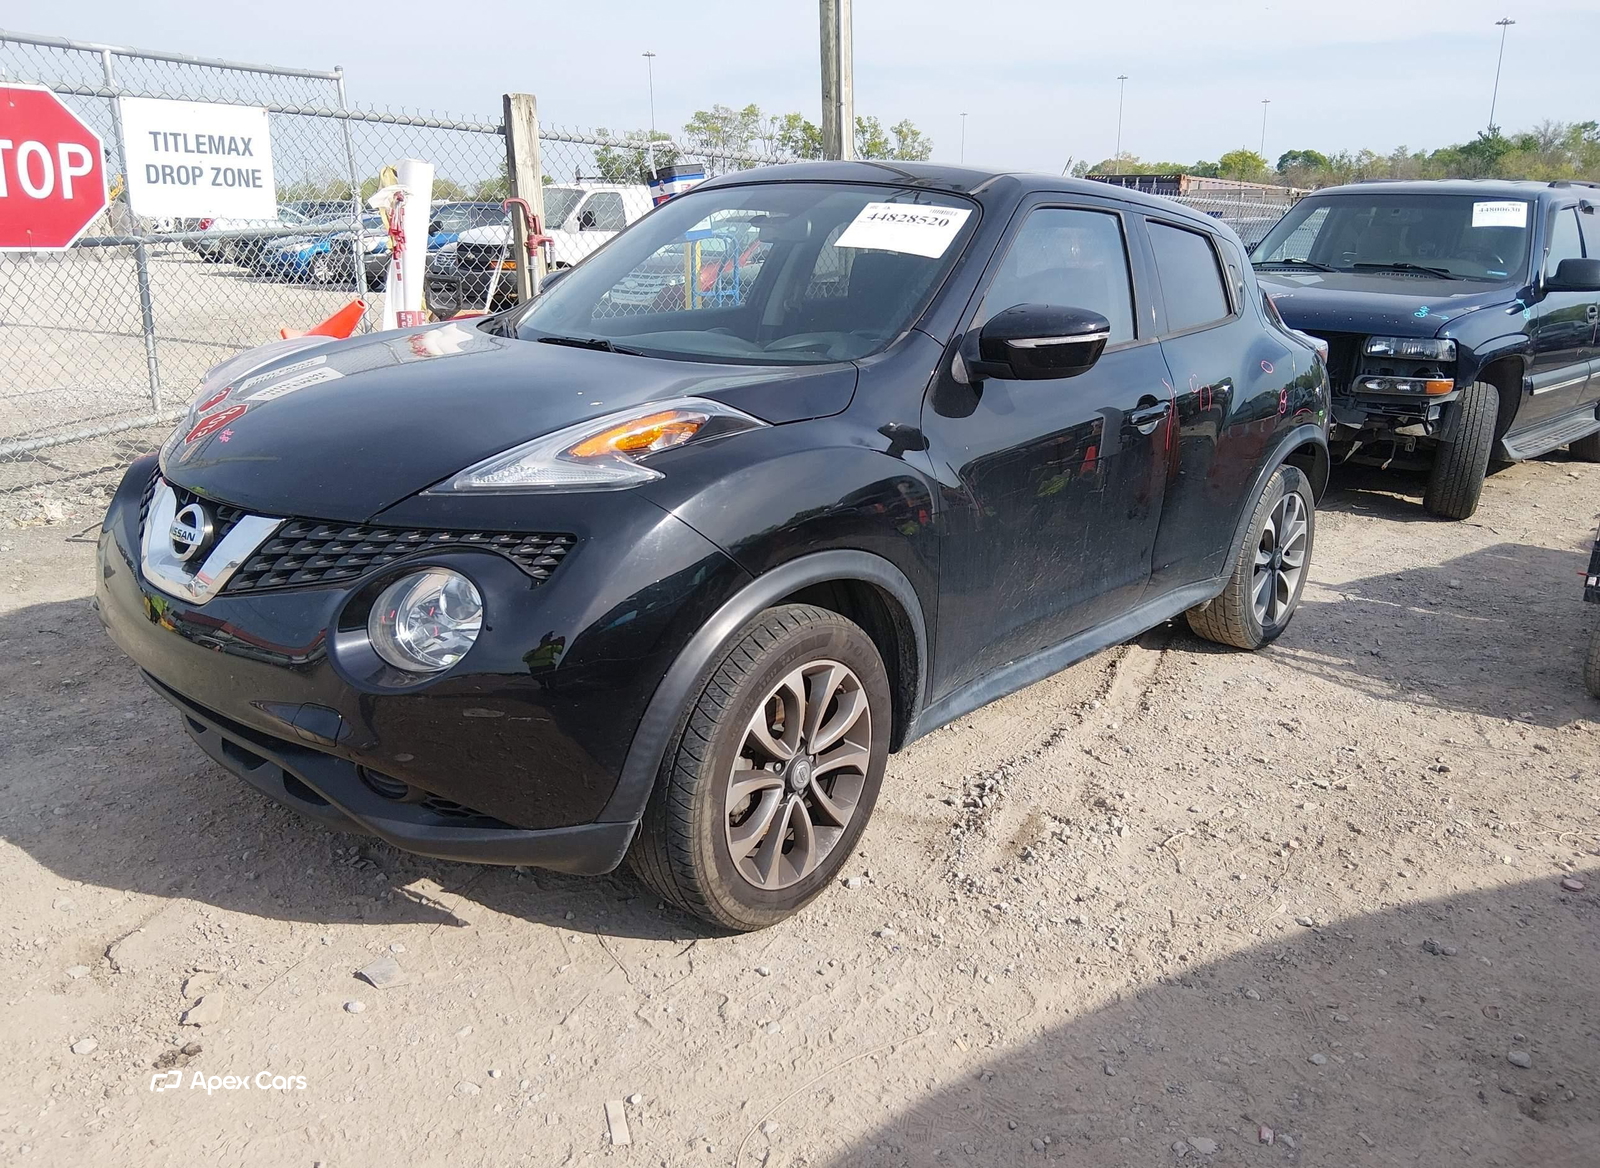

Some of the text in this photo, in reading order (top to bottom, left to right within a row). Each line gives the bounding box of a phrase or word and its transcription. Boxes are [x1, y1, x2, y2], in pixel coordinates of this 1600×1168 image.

[148, 131, 254, 157] TITLEMAX
[0, 139, 93, 199] TOP
[145, 163, 263, 188] DROP ZONE
[866, 212, 950, 228] 44828520
[171, 527, 196, 542] SSAN
